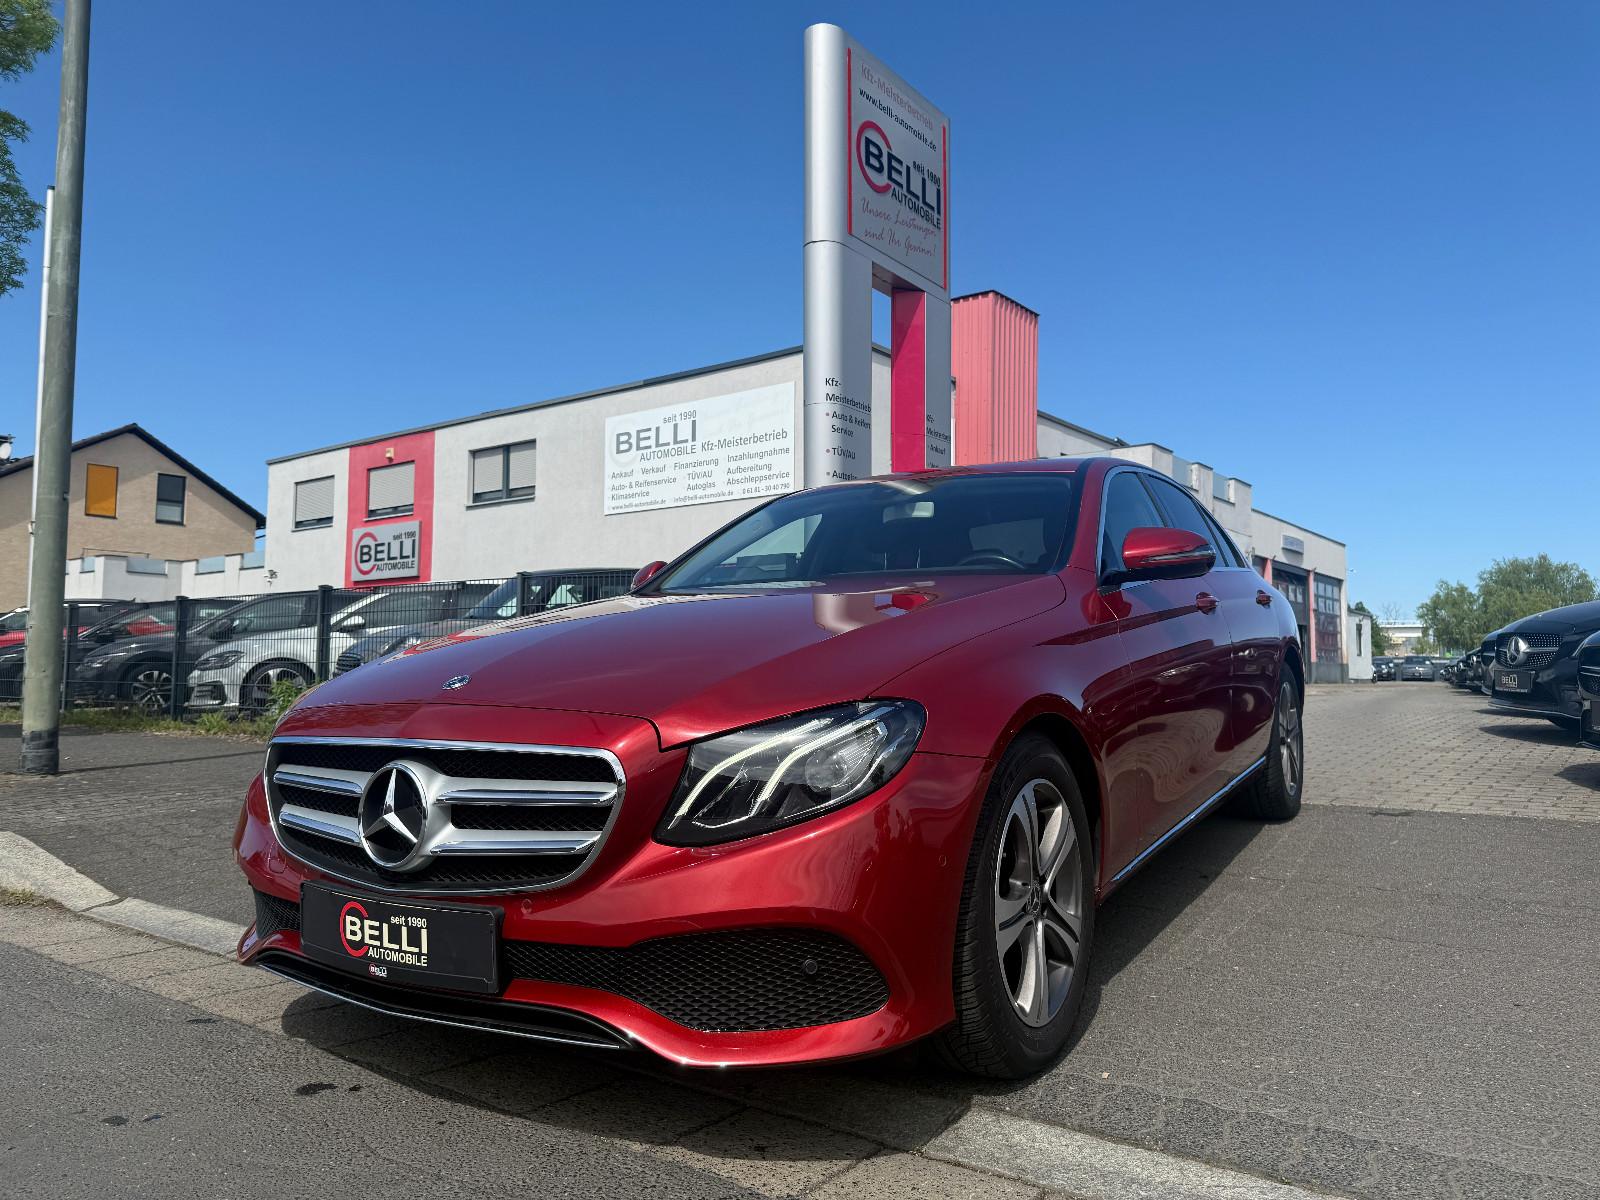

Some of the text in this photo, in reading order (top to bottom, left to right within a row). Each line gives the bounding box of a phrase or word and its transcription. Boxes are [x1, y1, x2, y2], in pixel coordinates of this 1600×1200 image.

[859, 87, 937, 152] www.belli-automobile.de
[864, 135, 941, 217] BELLI
[912, 160, 941, 188] seit 1990
[861, 197, 890, 222] Unsere
[891, 187, 941, 231] AUTOMOBILE
[825, 377, 842, 387] Kfz-
[825, 392, 872, 413] Meisterbetrieb
[663, 410, 697, 424] seit 1990
[848, 414, 854, 424] &
[615, 419, 697, 455] BELLI
[701, 428, 788, 452] Kfz-Meisterbetrieb
[831, 424, 854, 438] Service
[611, 447, 790, 480] Ankauf Verkauf Finanzierung Inzahlungnahme
[640, 445, 697, 462] AUTOMOBILE
[831, 446, 856, 459] TÜV/AU
[611, 463, 772, 492] Auto- & Reifenservice TÜV/AU Aufbereitung
[611, 471, 790, 501] Klimaservice Autoglas Abschleppservice
[360, 539, 416, 564] BELLI
[376, 560, 415, 572] AUTOMOBILE
[390, 915, 427, 928] seit 1990
[345, 915, 428, 954] BELLI
[368, 946, 428, 967] AUTOMOBILE
